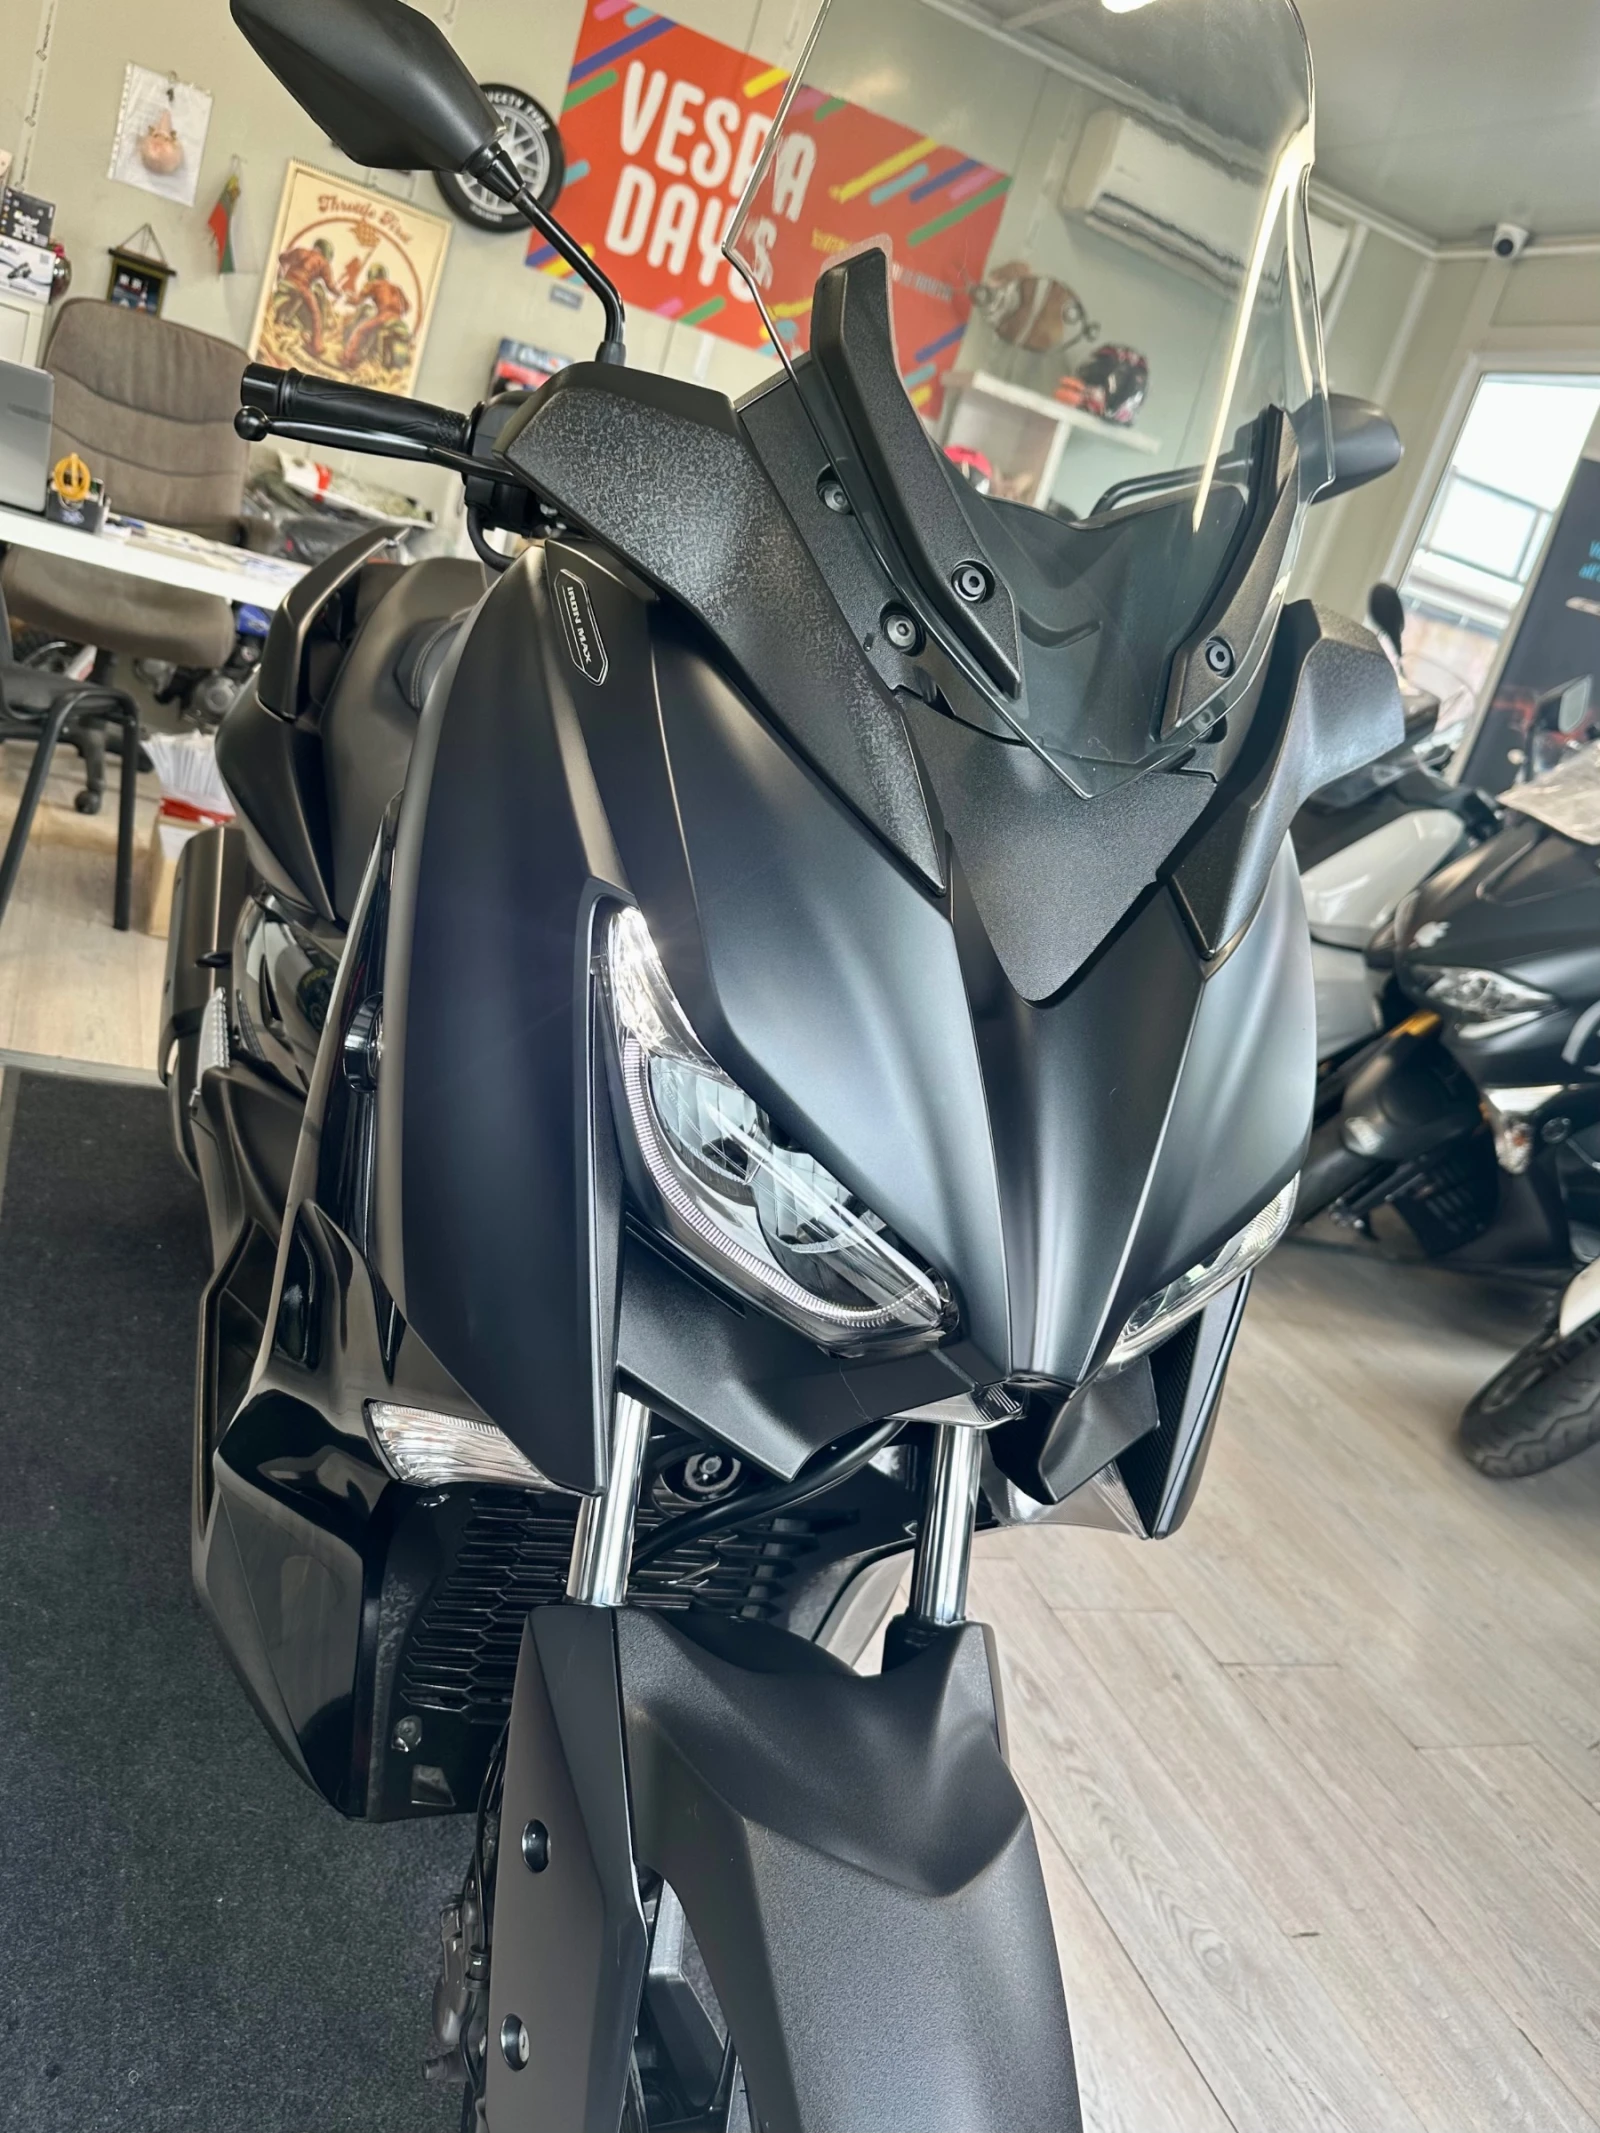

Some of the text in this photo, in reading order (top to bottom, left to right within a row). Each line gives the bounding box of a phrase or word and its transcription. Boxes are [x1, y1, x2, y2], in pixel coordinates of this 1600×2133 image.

[620, 60, 817, 223] VESPA
[604, 163, 777, 303] DAYS
[567, 586, 592, 664] IRON MAX
